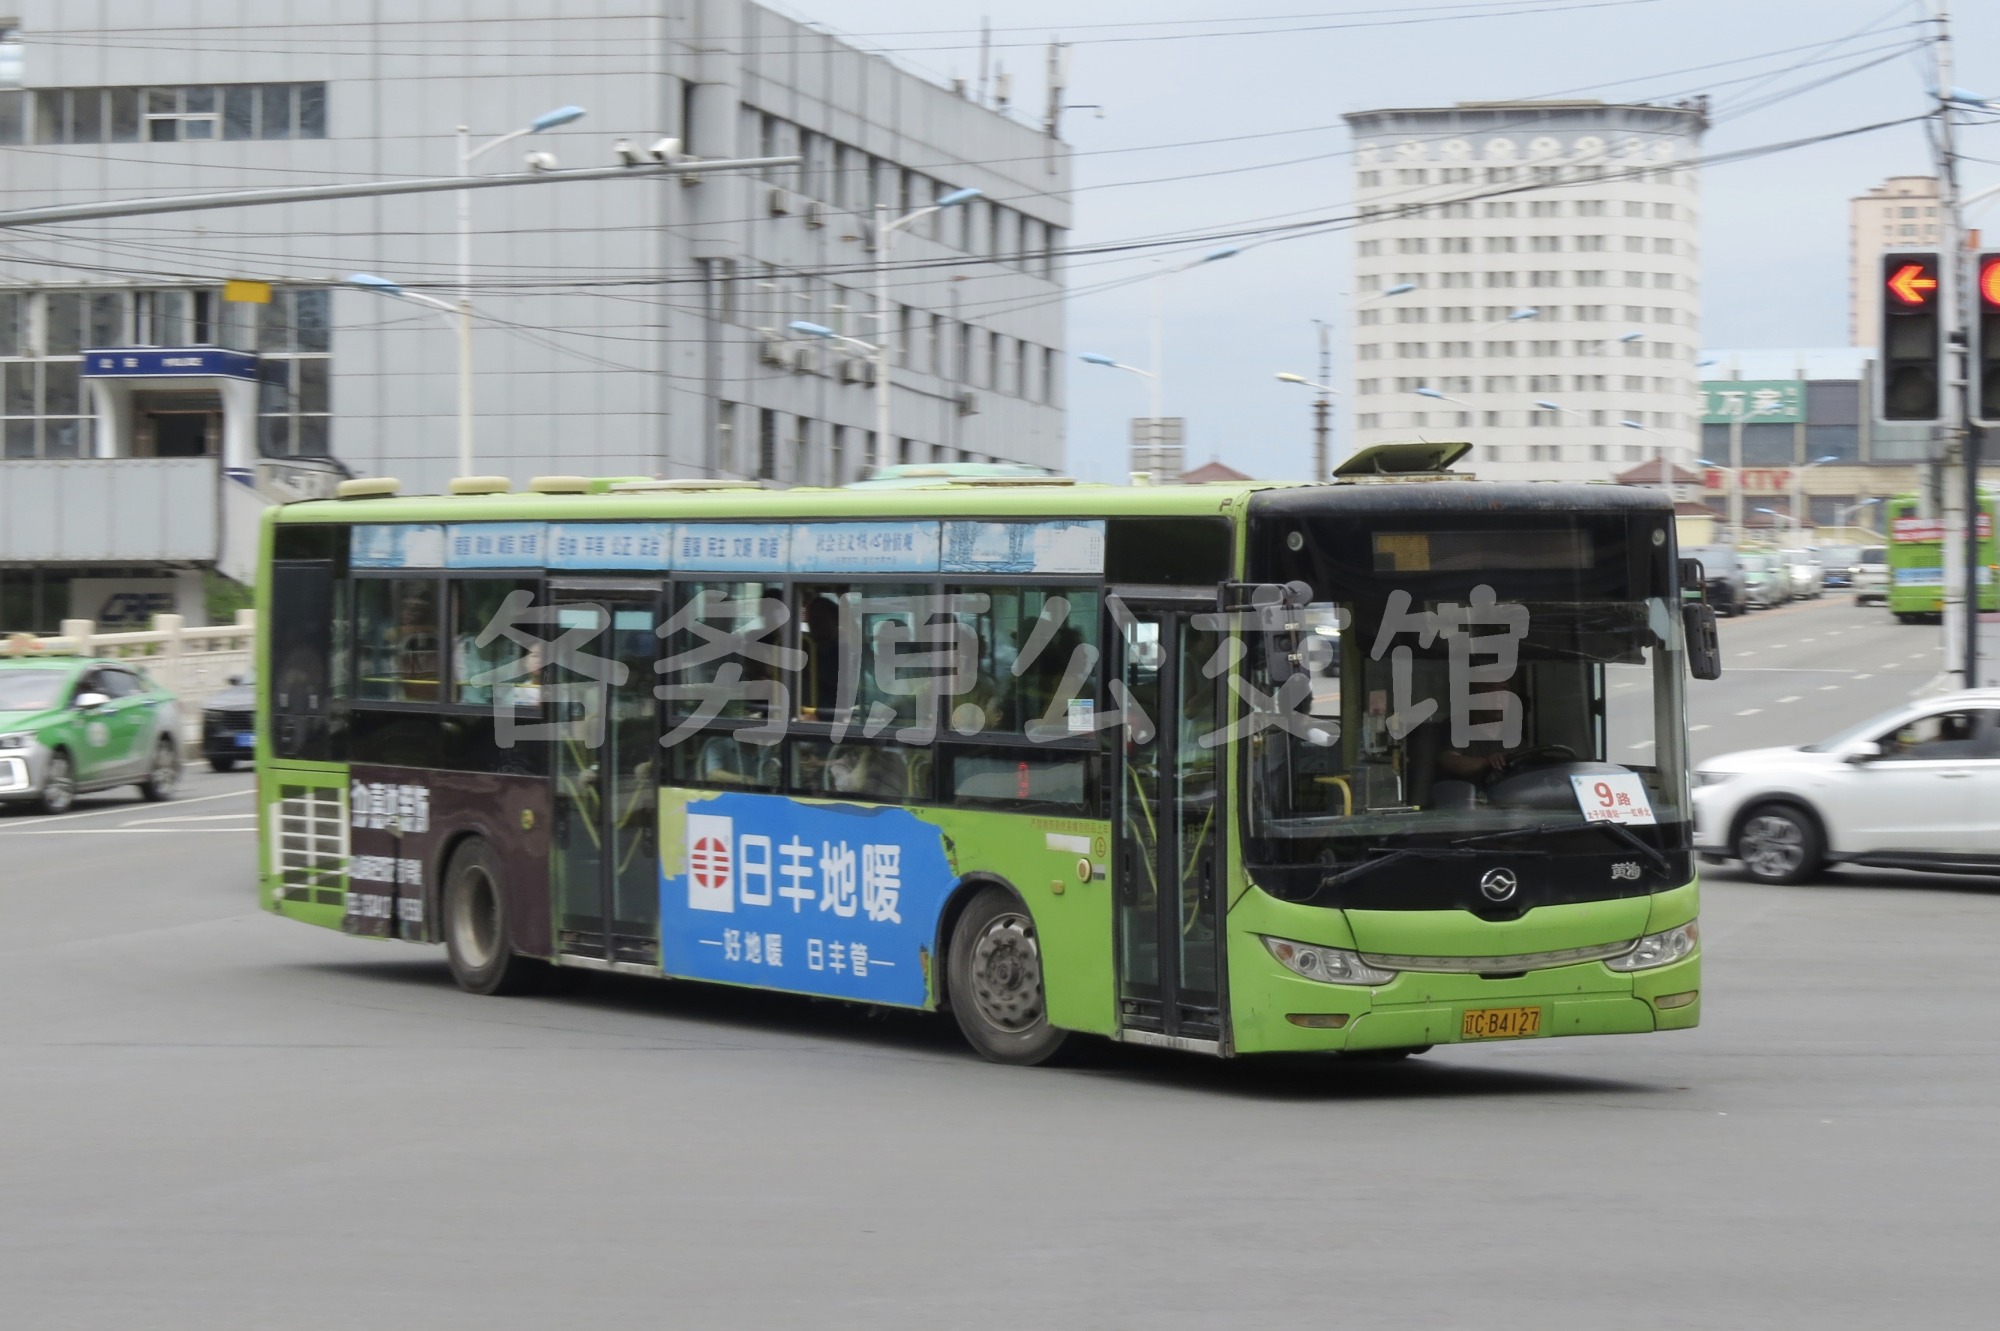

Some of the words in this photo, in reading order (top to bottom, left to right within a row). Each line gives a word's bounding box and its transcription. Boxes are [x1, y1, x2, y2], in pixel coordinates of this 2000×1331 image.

[740, 834, 902, 924] 日丰地暖
[1611, 862, 1641, 880] 黄海
